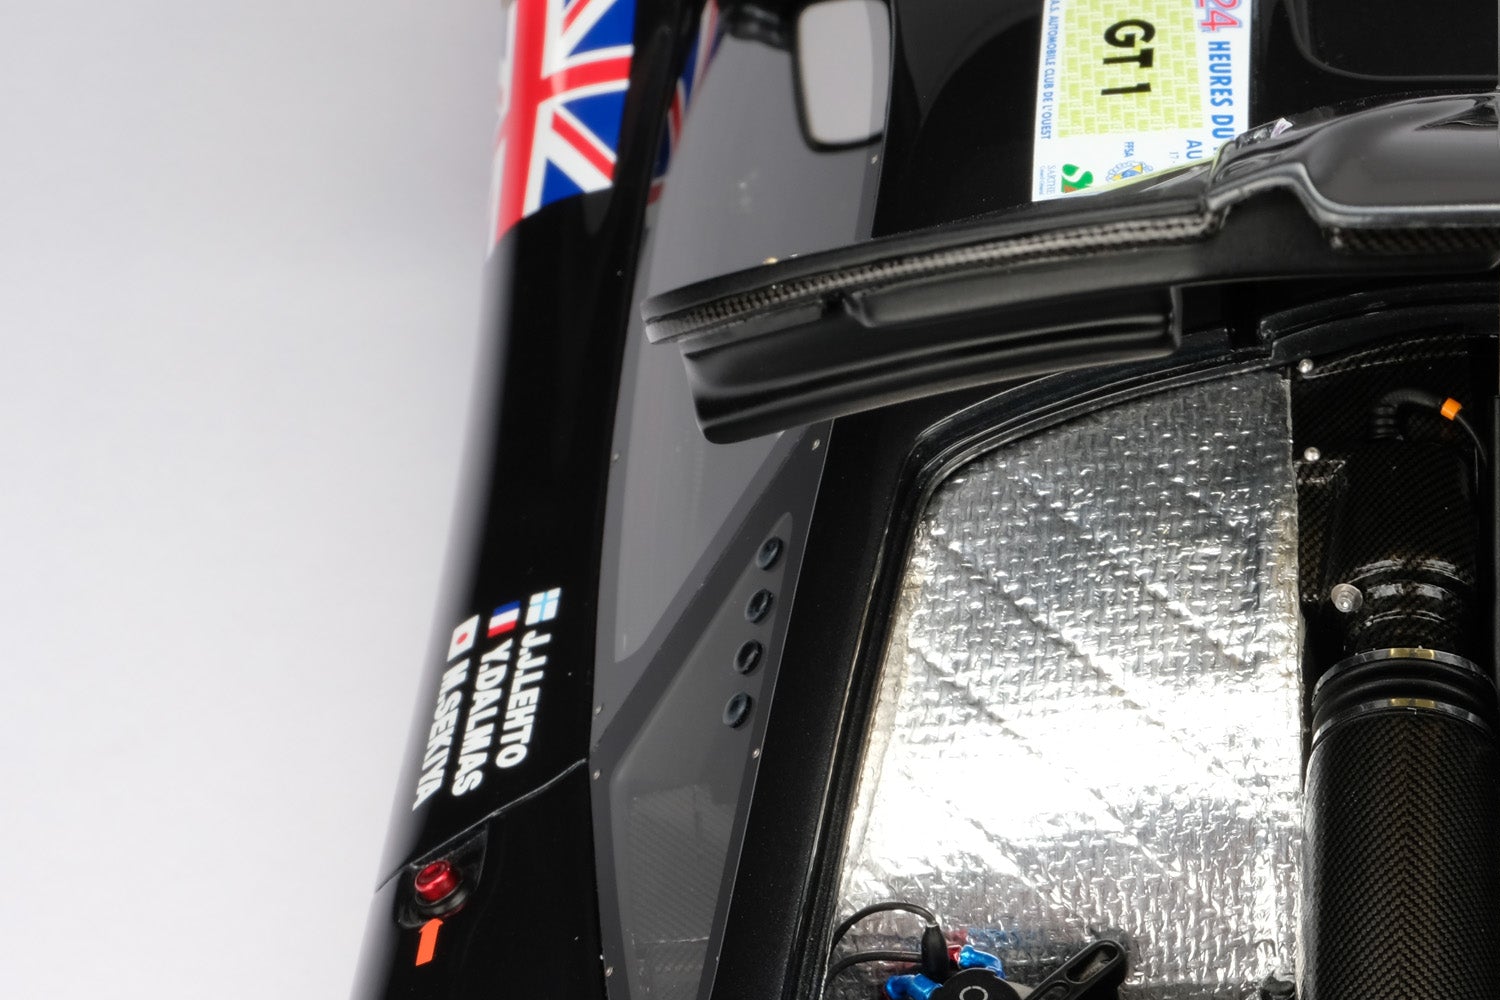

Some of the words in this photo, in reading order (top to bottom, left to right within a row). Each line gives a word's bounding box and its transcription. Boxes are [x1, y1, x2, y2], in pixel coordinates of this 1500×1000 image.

[1045, 15, 1060, 66] AUTOMOBILE
[1042, 91, 1054, 102] DE
[1043, 67, 1055, 89] CLUB
[1208, 41, 1234, 107] HEURES
[1040, 105, 1053, 139] L'OUEST
[1211, 114, 1235, 140] DU
[451, 638, 513, 797] Y.DALMAS
[495, 630, 552, 768] J.J.LEHTO
[412, 658, 470, 812] M.SEKIYA
